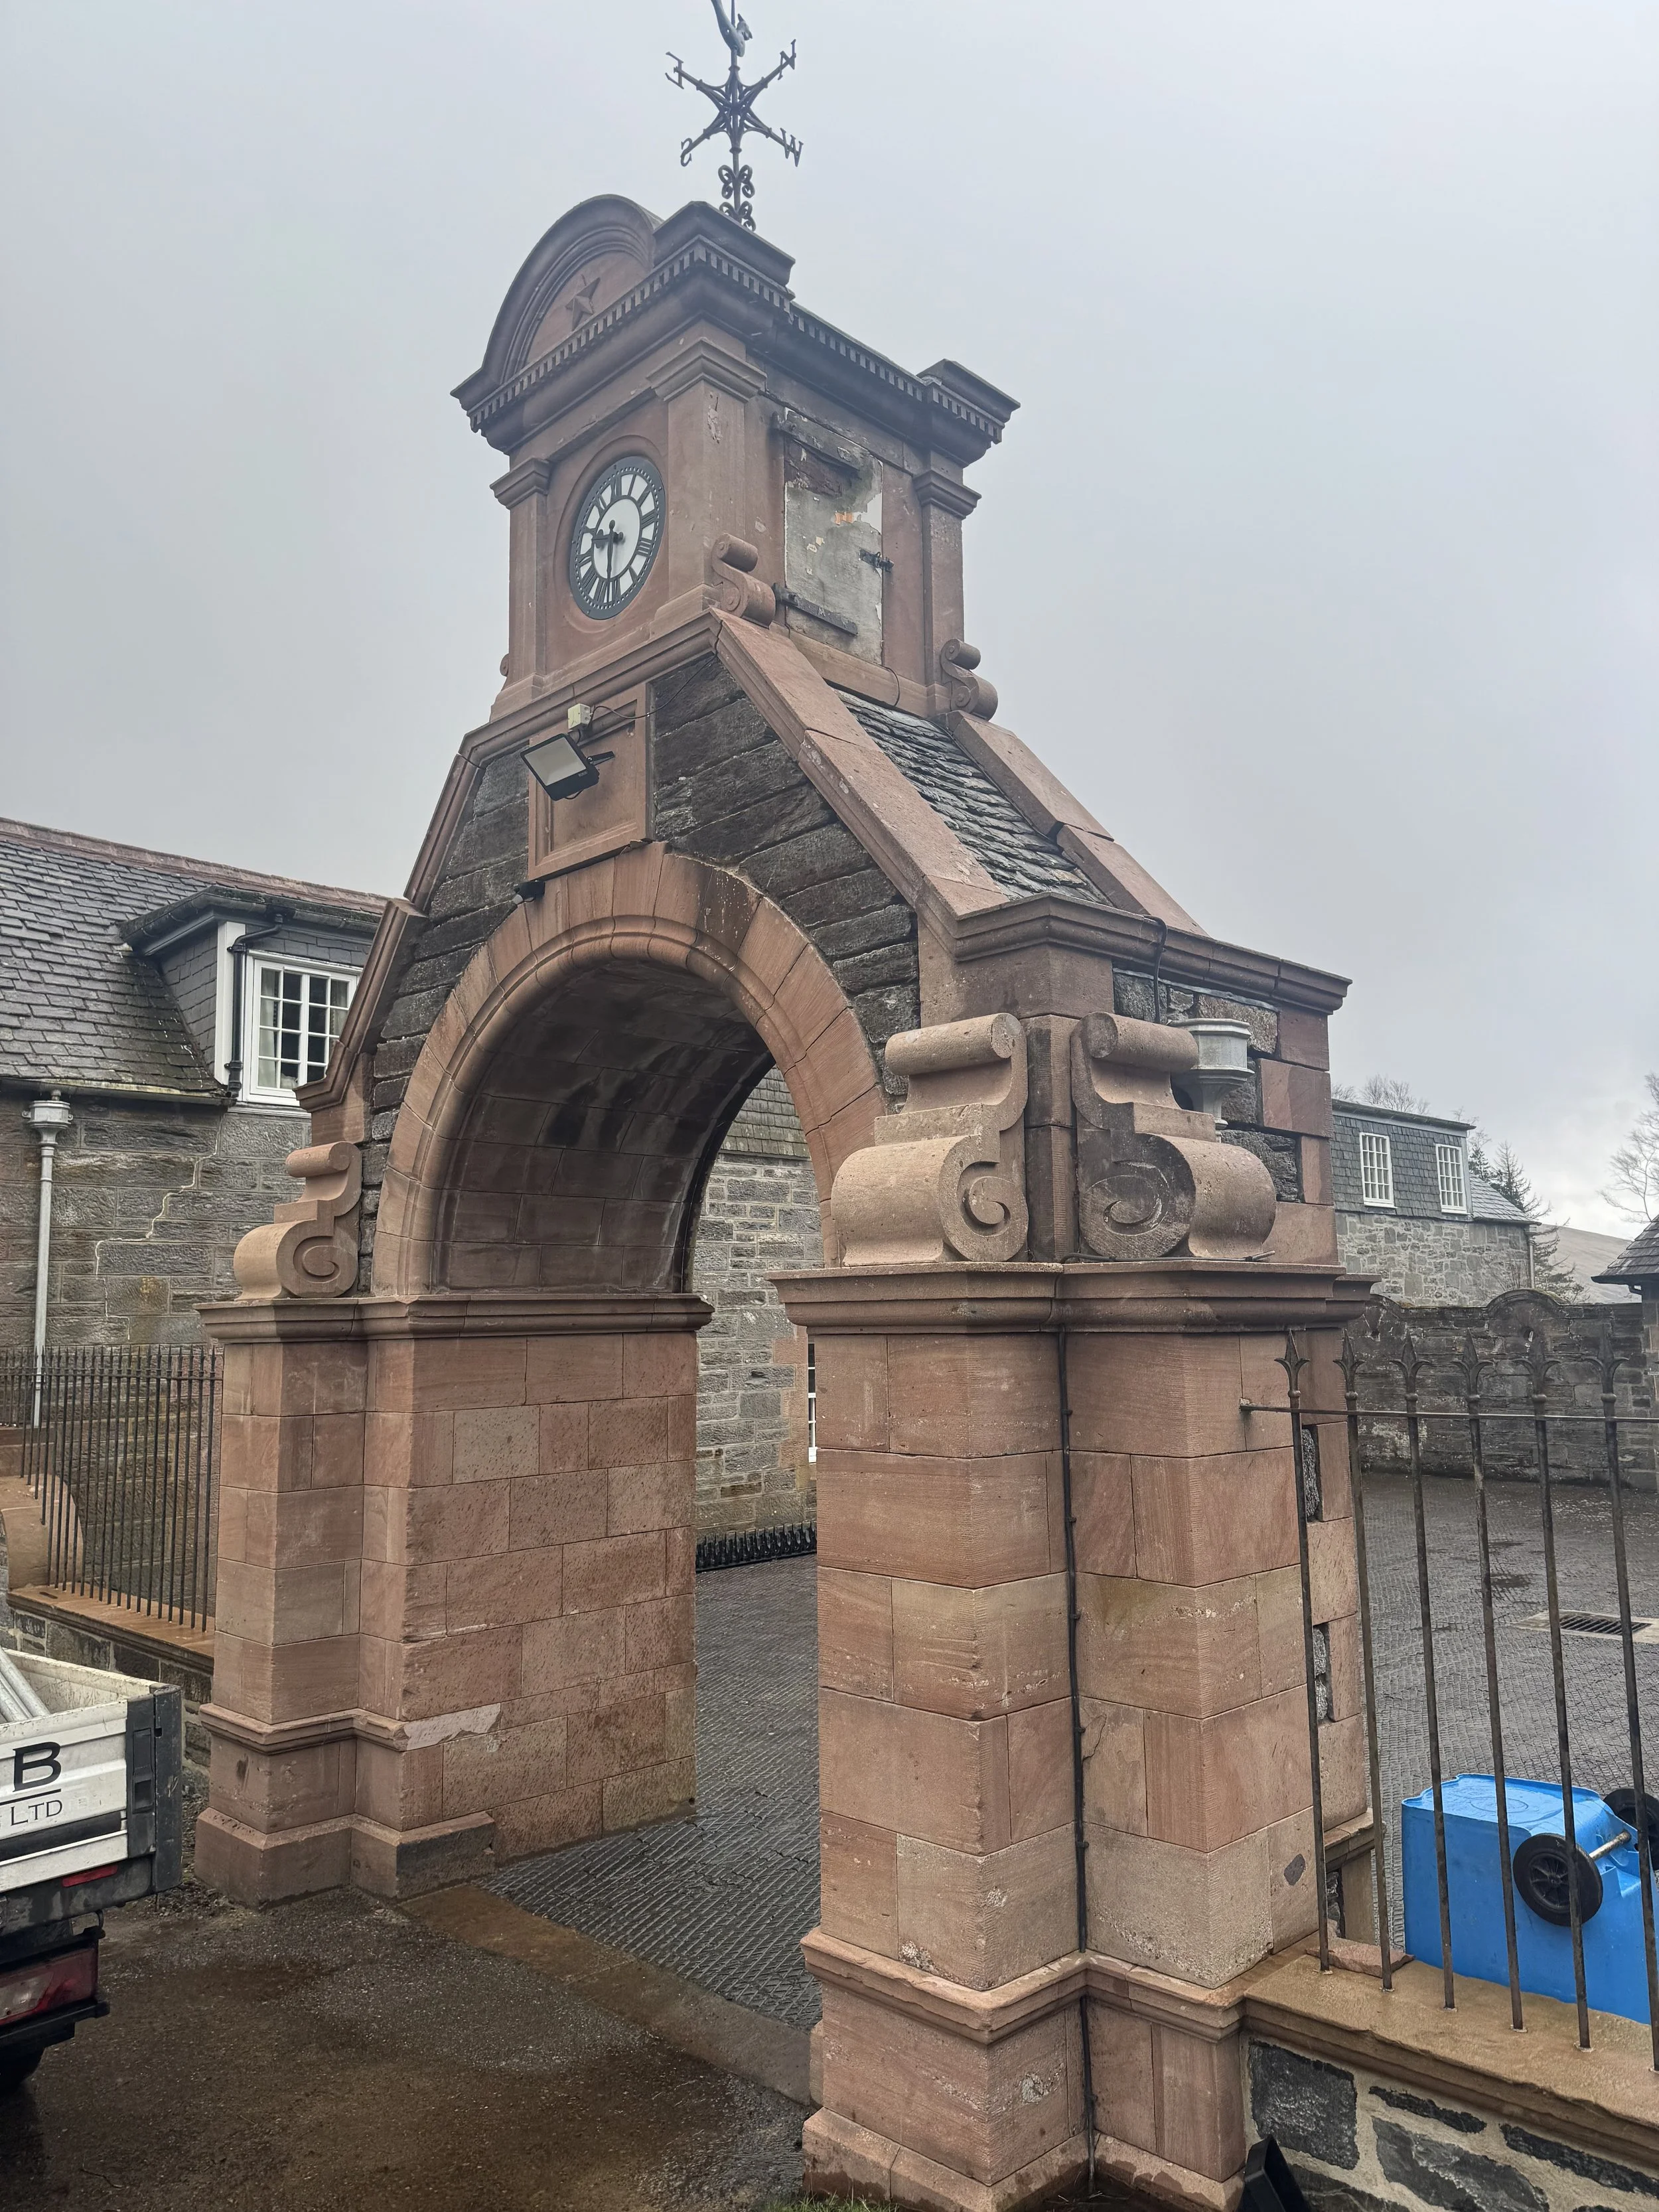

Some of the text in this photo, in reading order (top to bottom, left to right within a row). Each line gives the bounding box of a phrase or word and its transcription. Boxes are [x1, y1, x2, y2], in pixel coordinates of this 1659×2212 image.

[778, 38, 796, 80] N
[780, 127, 804, 167] W
[13, 1741, 62, 1792] B
[11, 1800, 63, 1826] LTD
